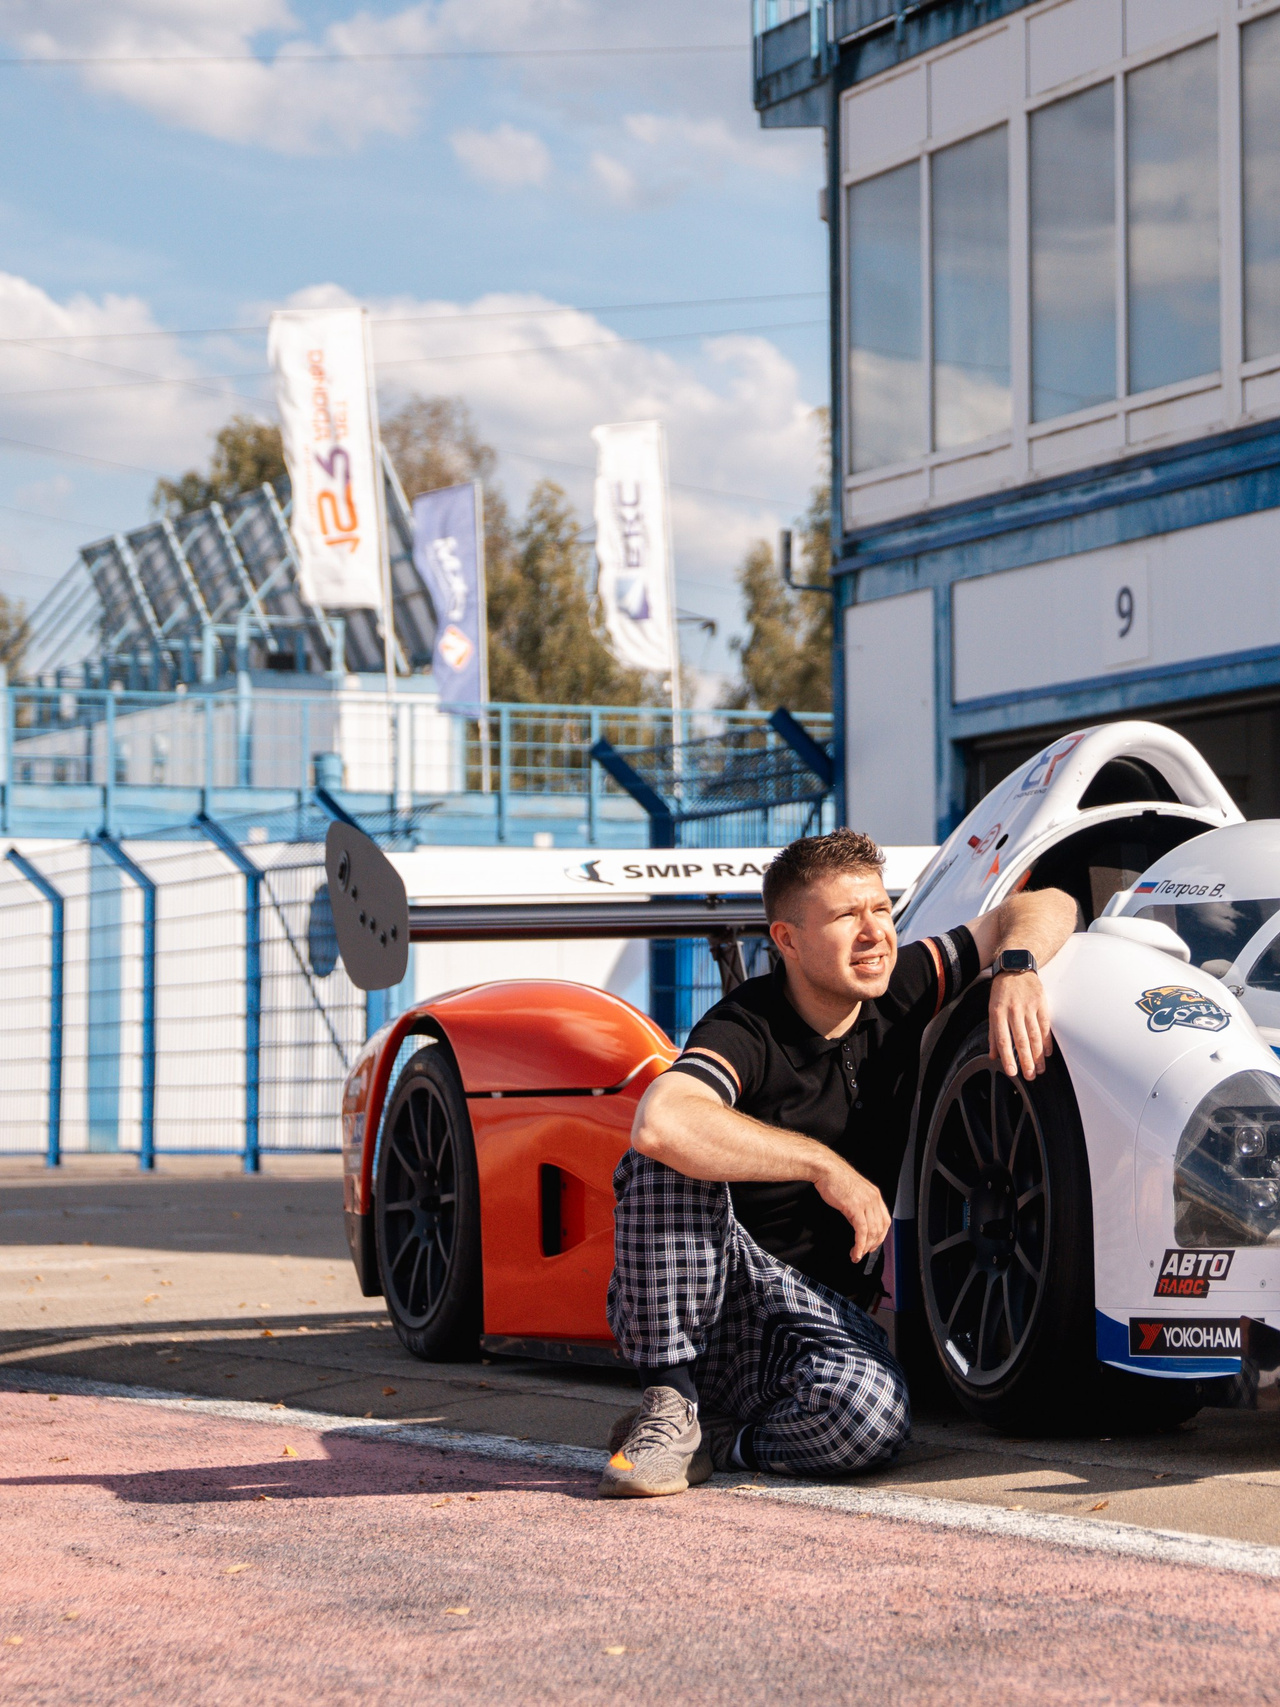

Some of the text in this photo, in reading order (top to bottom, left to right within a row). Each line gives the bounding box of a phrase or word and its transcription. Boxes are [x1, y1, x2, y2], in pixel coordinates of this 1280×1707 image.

[1116, 586, 1133, 638] 9
[623, 863, 703, 879] SMP
[1154, 880, 1226, 898] Петров В.
[1161, 1253, 1230, 1277] АВТО
[1157, 1278, 1204, 1295] ПЛЮС
[1163, 1326, 1241, 1348] YOKOHAM
